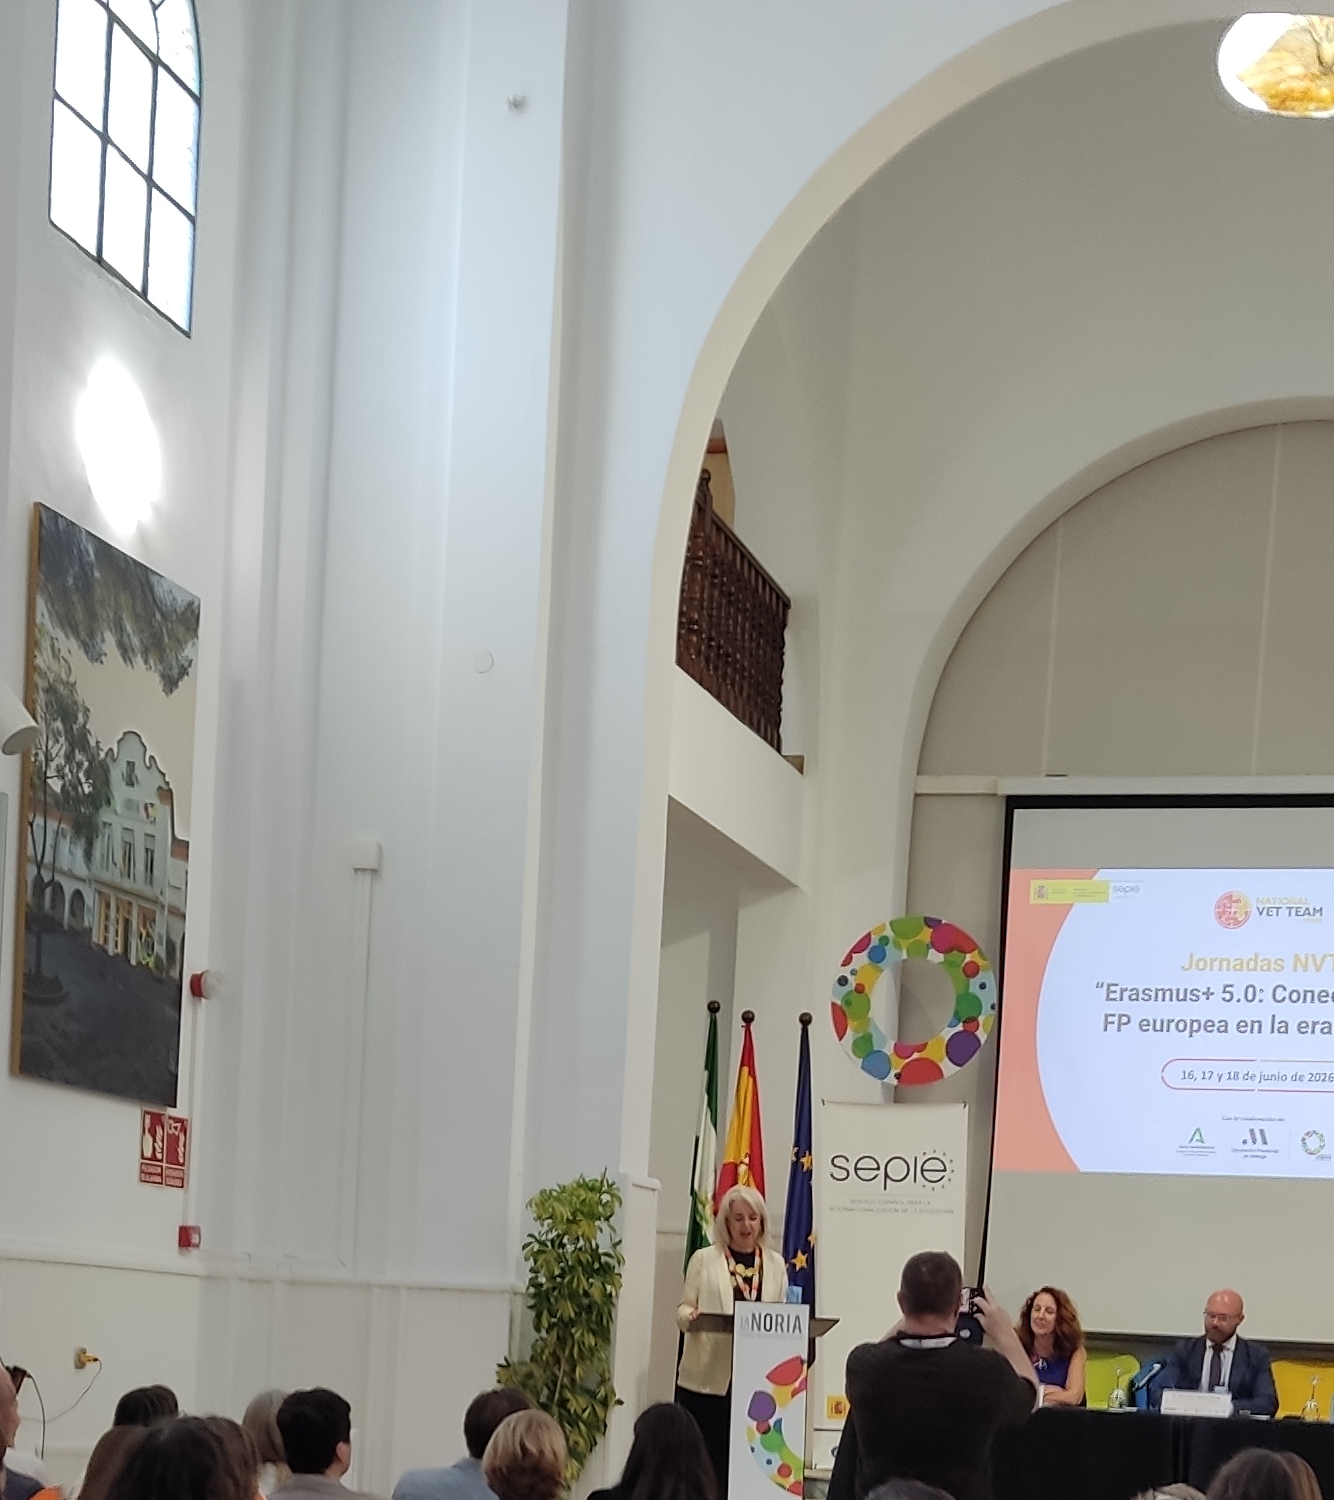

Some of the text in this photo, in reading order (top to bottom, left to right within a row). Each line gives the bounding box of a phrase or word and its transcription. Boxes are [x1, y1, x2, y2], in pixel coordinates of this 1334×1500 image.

[1256, 906, 1323, 917] VET TEAM
[1181, 952, 1285, 972] Jornadas
[1221, 983, 1265, 1003] 5.0:
[1102, 1013, 1131, 1033] FP
[1138, 1017, 1229, 1038] europea
[1236, 1018, 1263, 1034] en
[1269, 1014, 1289, 1035] la
[1296, 1019, 1333, 1036] era
[1181, 1069, 1334, 1084] 16, 17 y 18 de junio de 2026
[829, 1154, 947, 1191] sepie
[751, 1312, 802, 1334] NORIA
